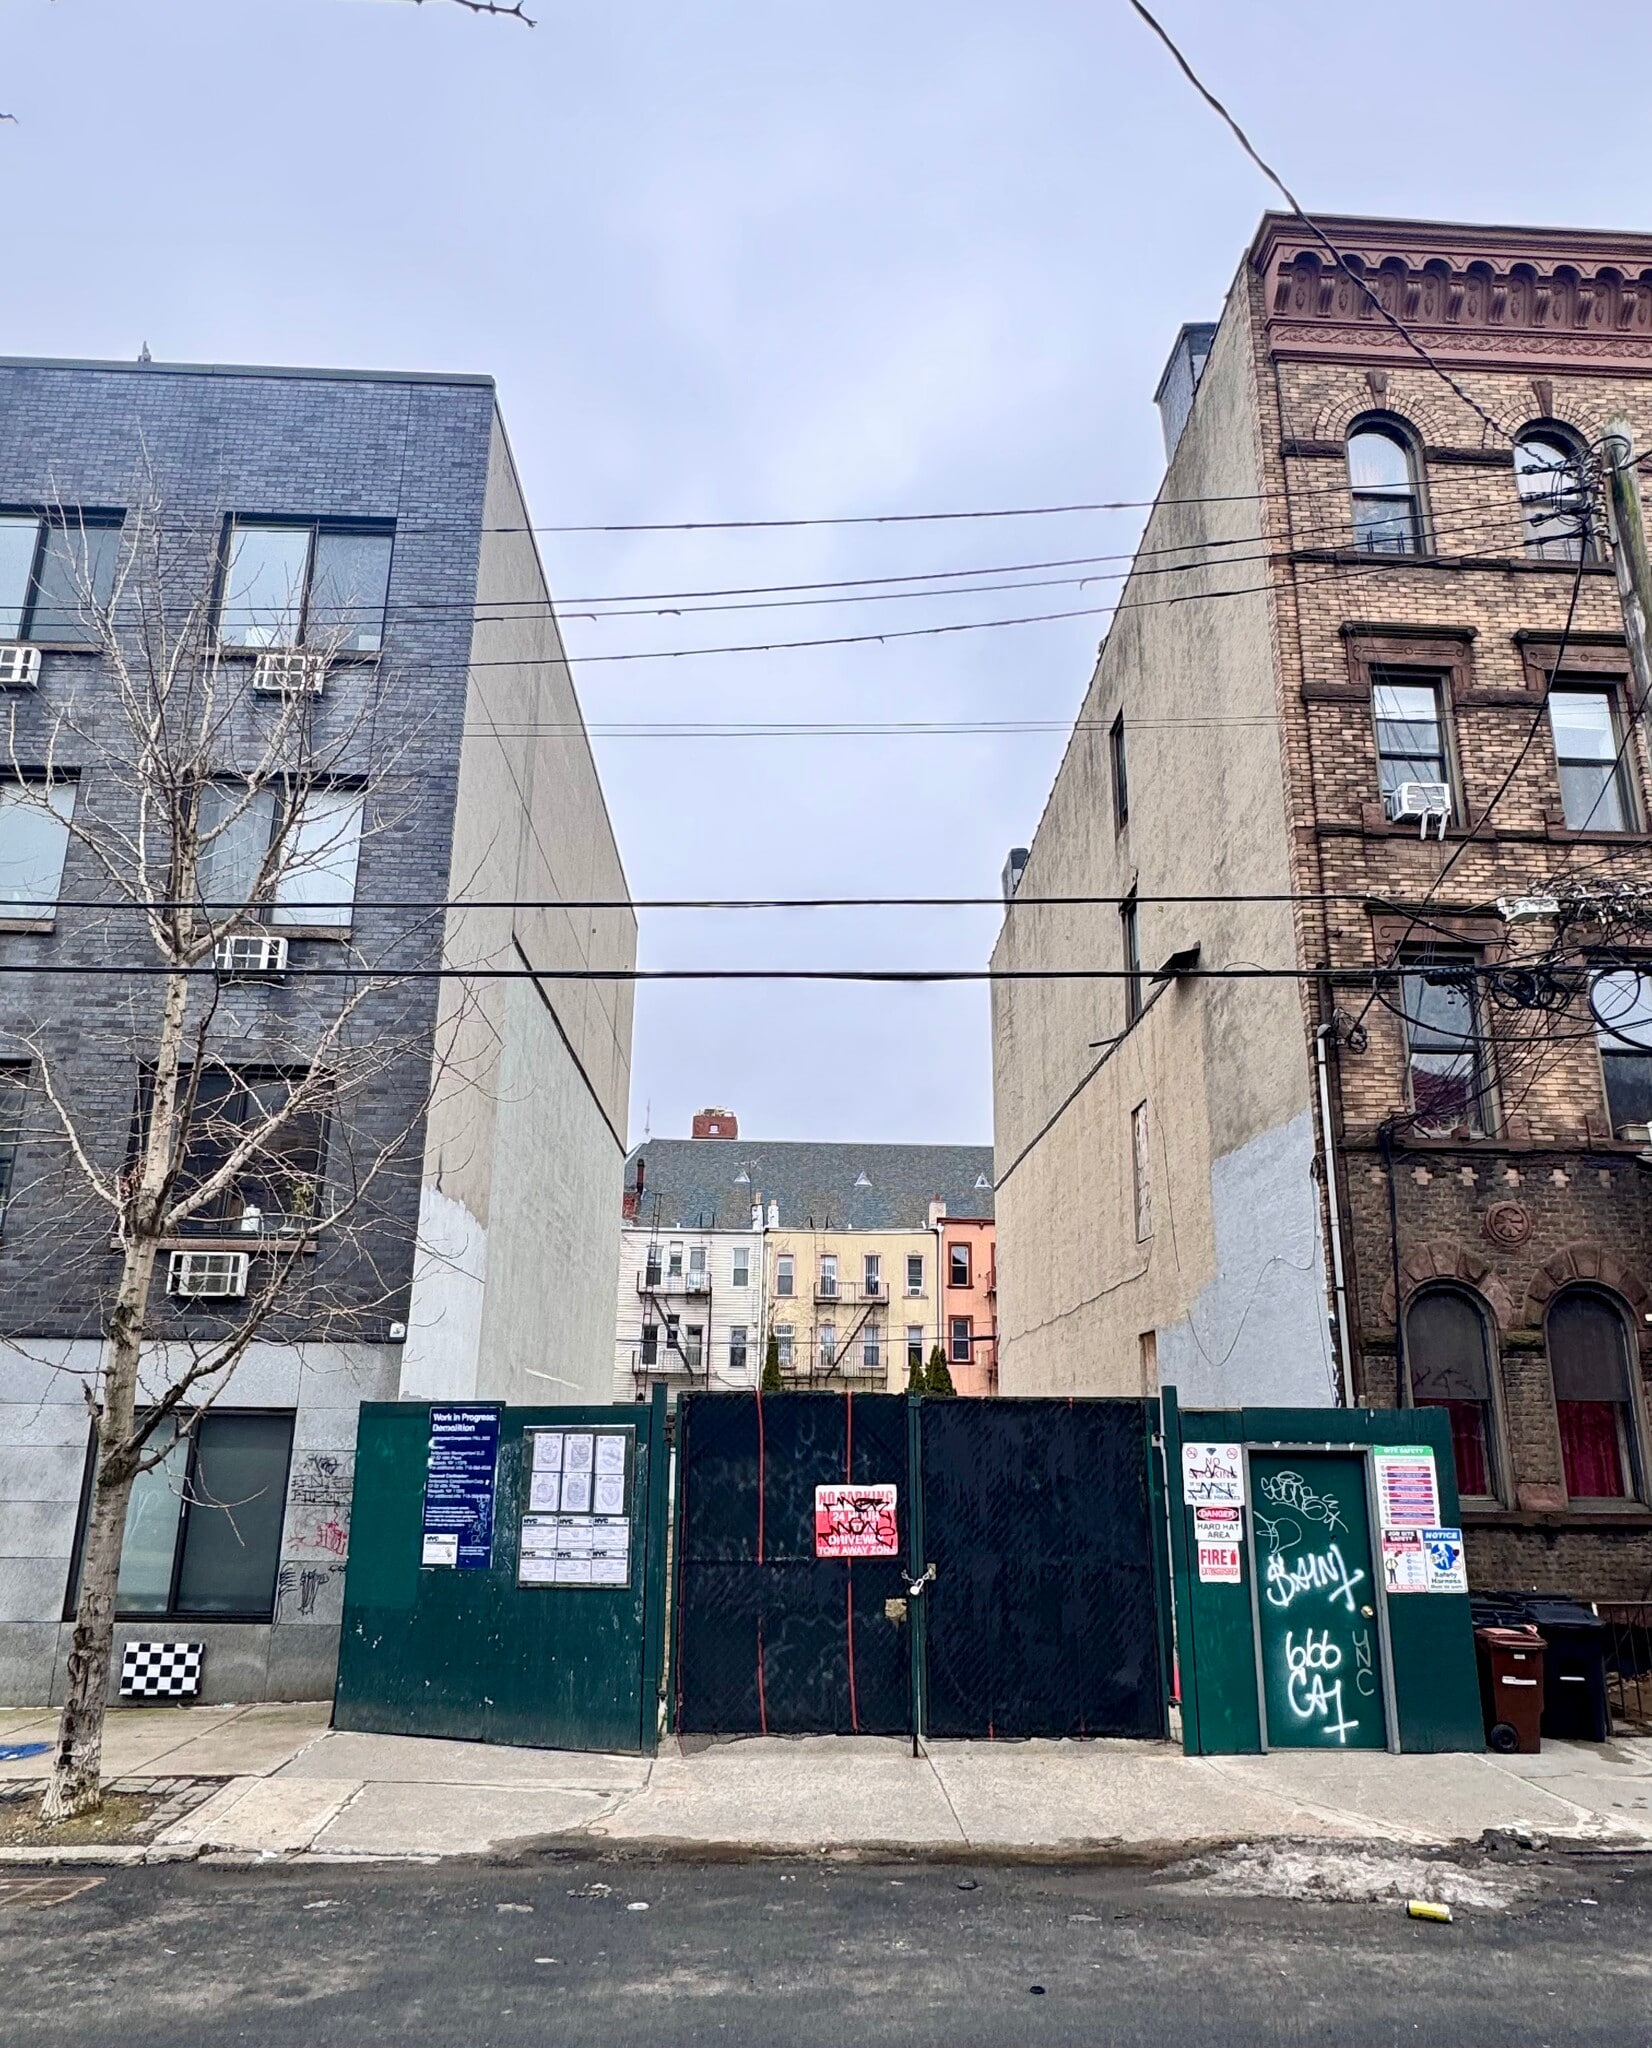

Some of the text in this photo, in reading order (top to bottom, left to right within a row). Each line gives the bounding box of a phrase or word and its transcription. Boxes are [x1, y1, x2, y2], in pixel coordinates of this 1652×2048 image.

[433, 1413, 452, 1421] Work
[462, 1413, 497, 1423] Progress:
[432, 1424, 476, 1432] Demolition
[1205, 1457, 1220, 1467] NO
[818, 1491, 836, 1505] NO
[832, 1511, 845, 1522] 24
[1201, 1510, 1234, 1518] DANGER
[1426, 1532, 1458, 1541] NOTICE
[818, 1546, 840, 1555] TOW
[841, 1545, 868, 1554] AWAY
[1200, 1549, 1228, 1565] FIRE
[1285, 1627, 1342, 1671] 666
[1287, 1668, 1360, 1744] CAT
